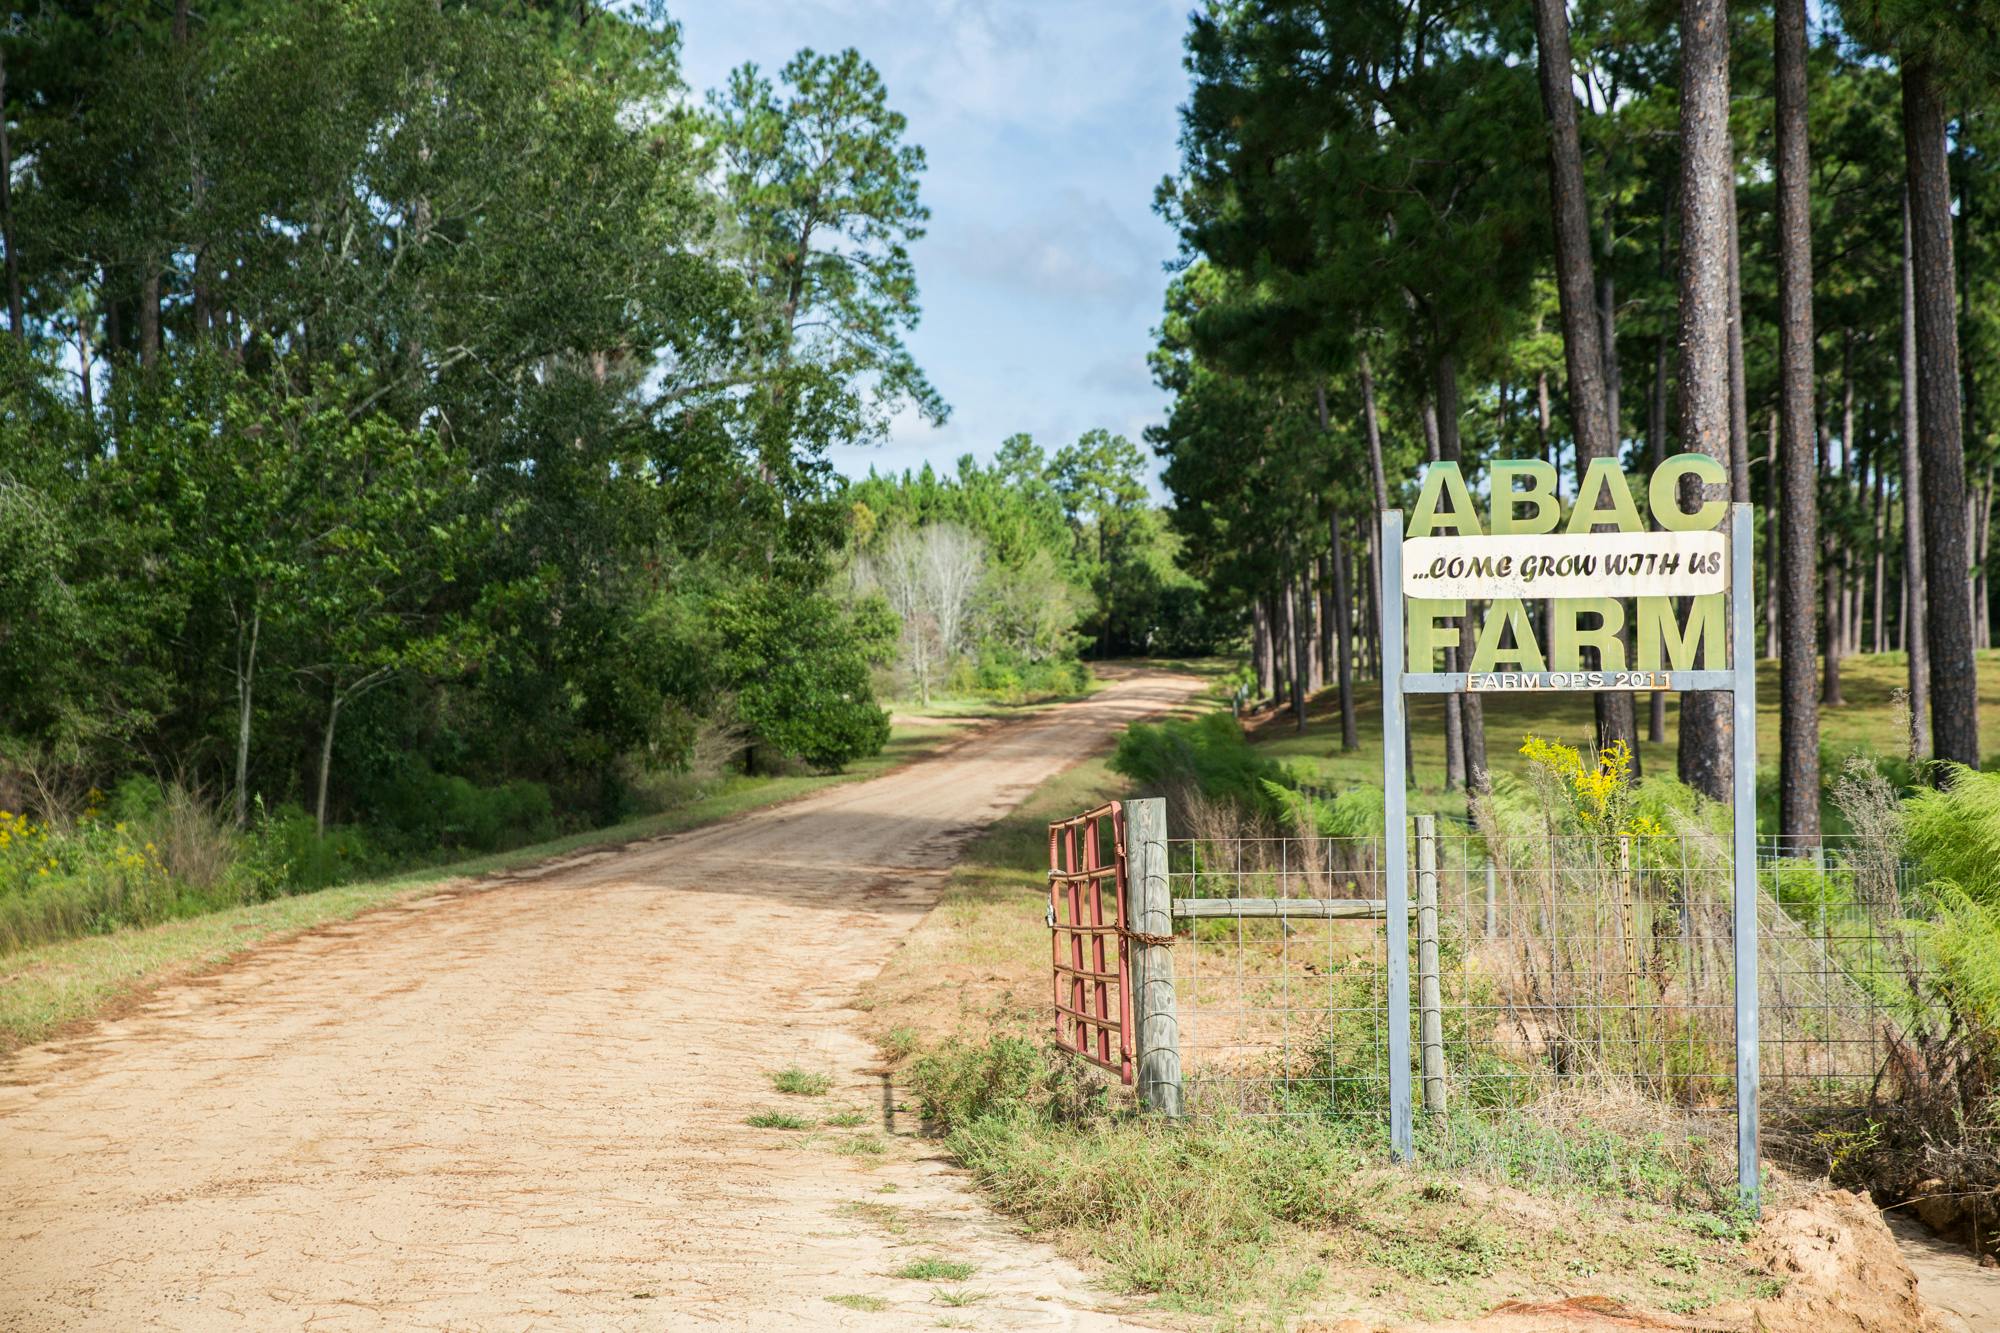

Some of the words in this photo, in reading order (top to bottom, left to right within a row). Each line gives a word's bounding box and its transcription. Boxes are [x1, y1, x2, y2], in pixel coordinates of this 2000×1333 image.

[1406, 453, 1729, 536] ABAC
[1412, 555, 1512, 580] ...COME
[1520, 554, 1597, 582] GROW
[1604, 552, 1680, 576] WITH
[1688, 551, 1721, 575] US
[1408, 596, 1726, 673] FARM
[1467, 673, 1540, 689] FARM
[1549, 672, 1604, 689] OPS
[1615, 672, 1671, 689] 2011
